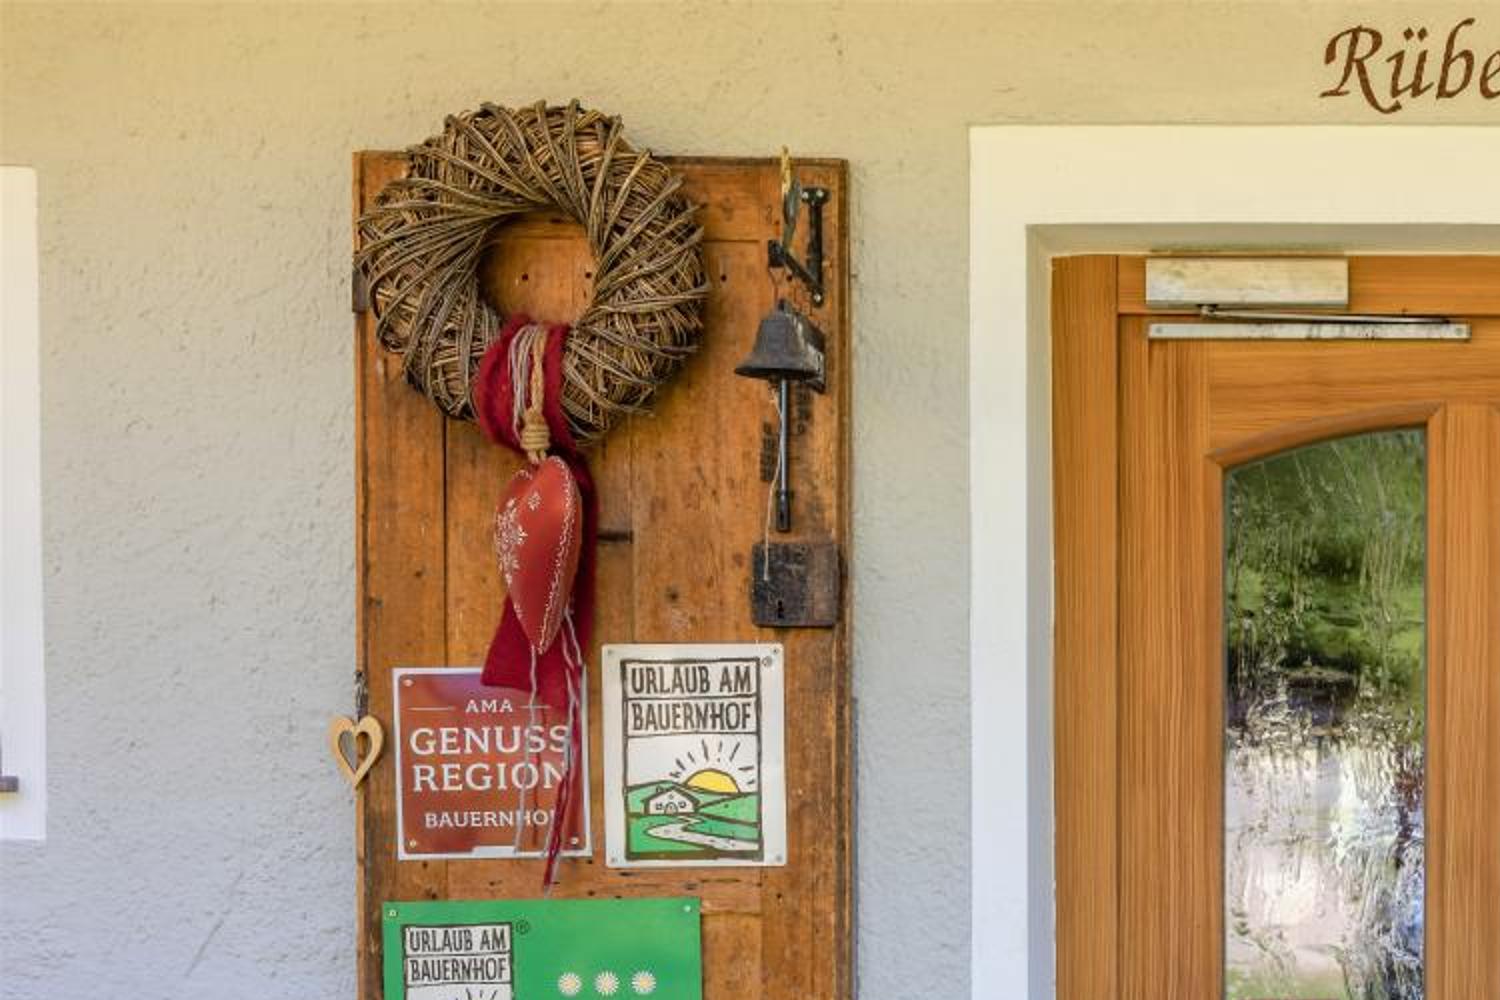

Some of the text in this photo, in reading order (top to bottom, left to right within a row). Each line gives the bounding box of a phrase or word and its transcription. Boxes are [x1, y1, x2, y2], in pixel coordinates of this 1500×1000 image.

[631, 665, 751, 694] URLAUB AM
[465, 699, 513, 714] AMA
[632, 702, 752, 731] BAUERNHOF
[409, 725, 570, 755] GENUSS
[409, 928, 506, 952] URLAUB AM
[410, 958, 507, 981] BAUERNHOF
